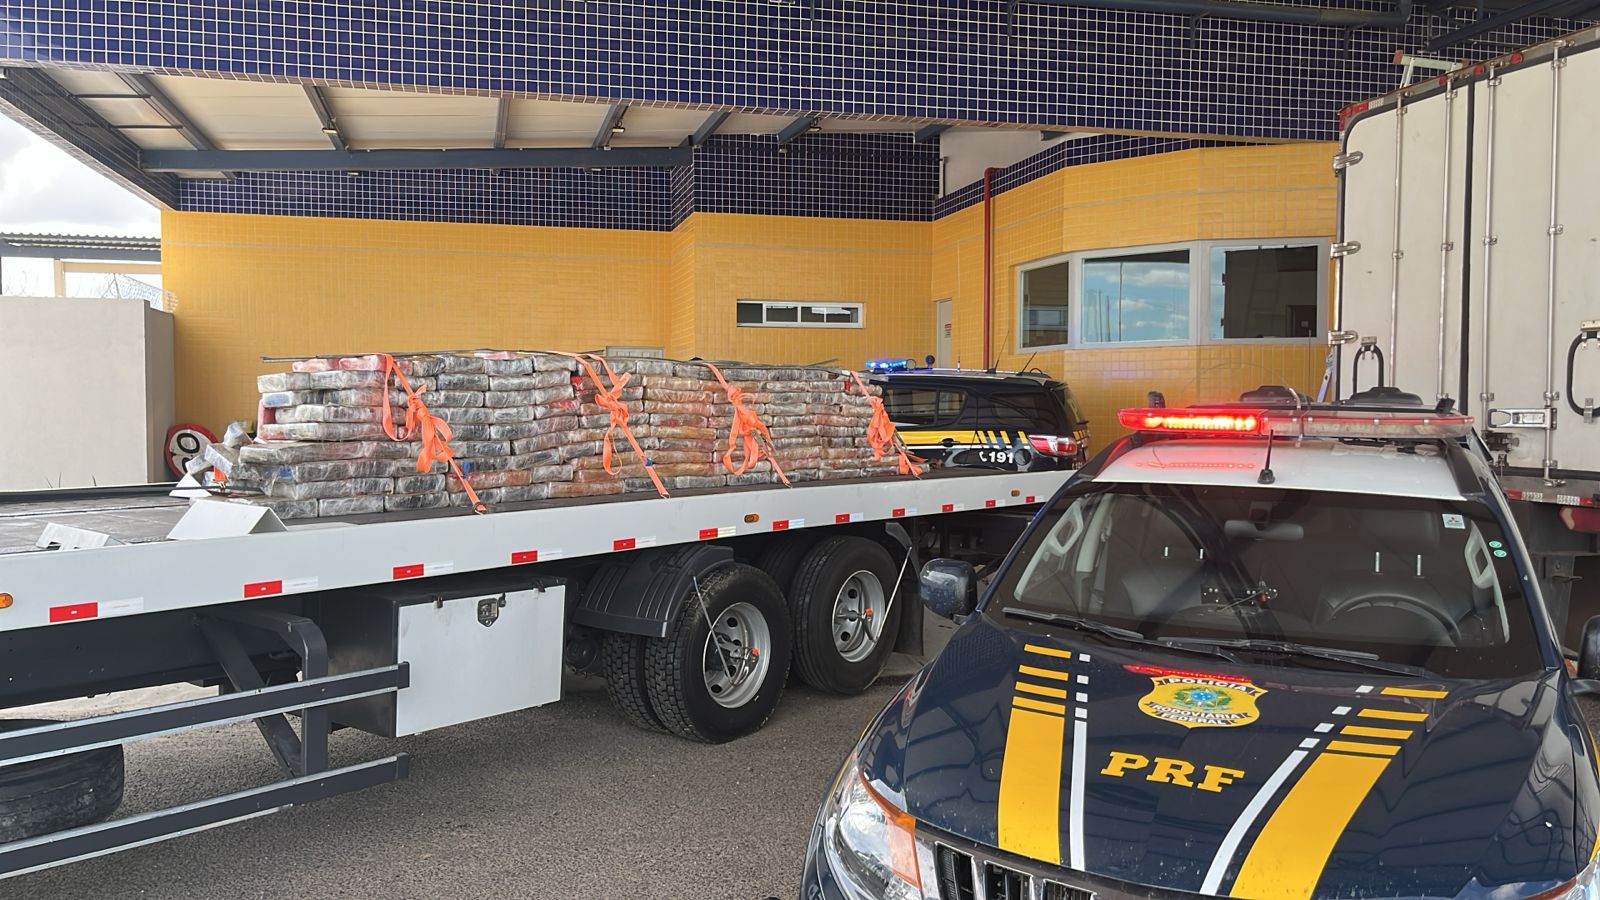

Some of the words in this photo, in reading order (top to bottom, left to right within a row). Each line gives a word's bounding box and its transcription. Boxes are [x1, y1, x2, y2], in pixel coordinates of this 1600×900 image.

[989, 451, 1014, 464] 191
[1161, 712, 1227, 725] FEDERAL
[1100, 751, 1245, 793] PRF
